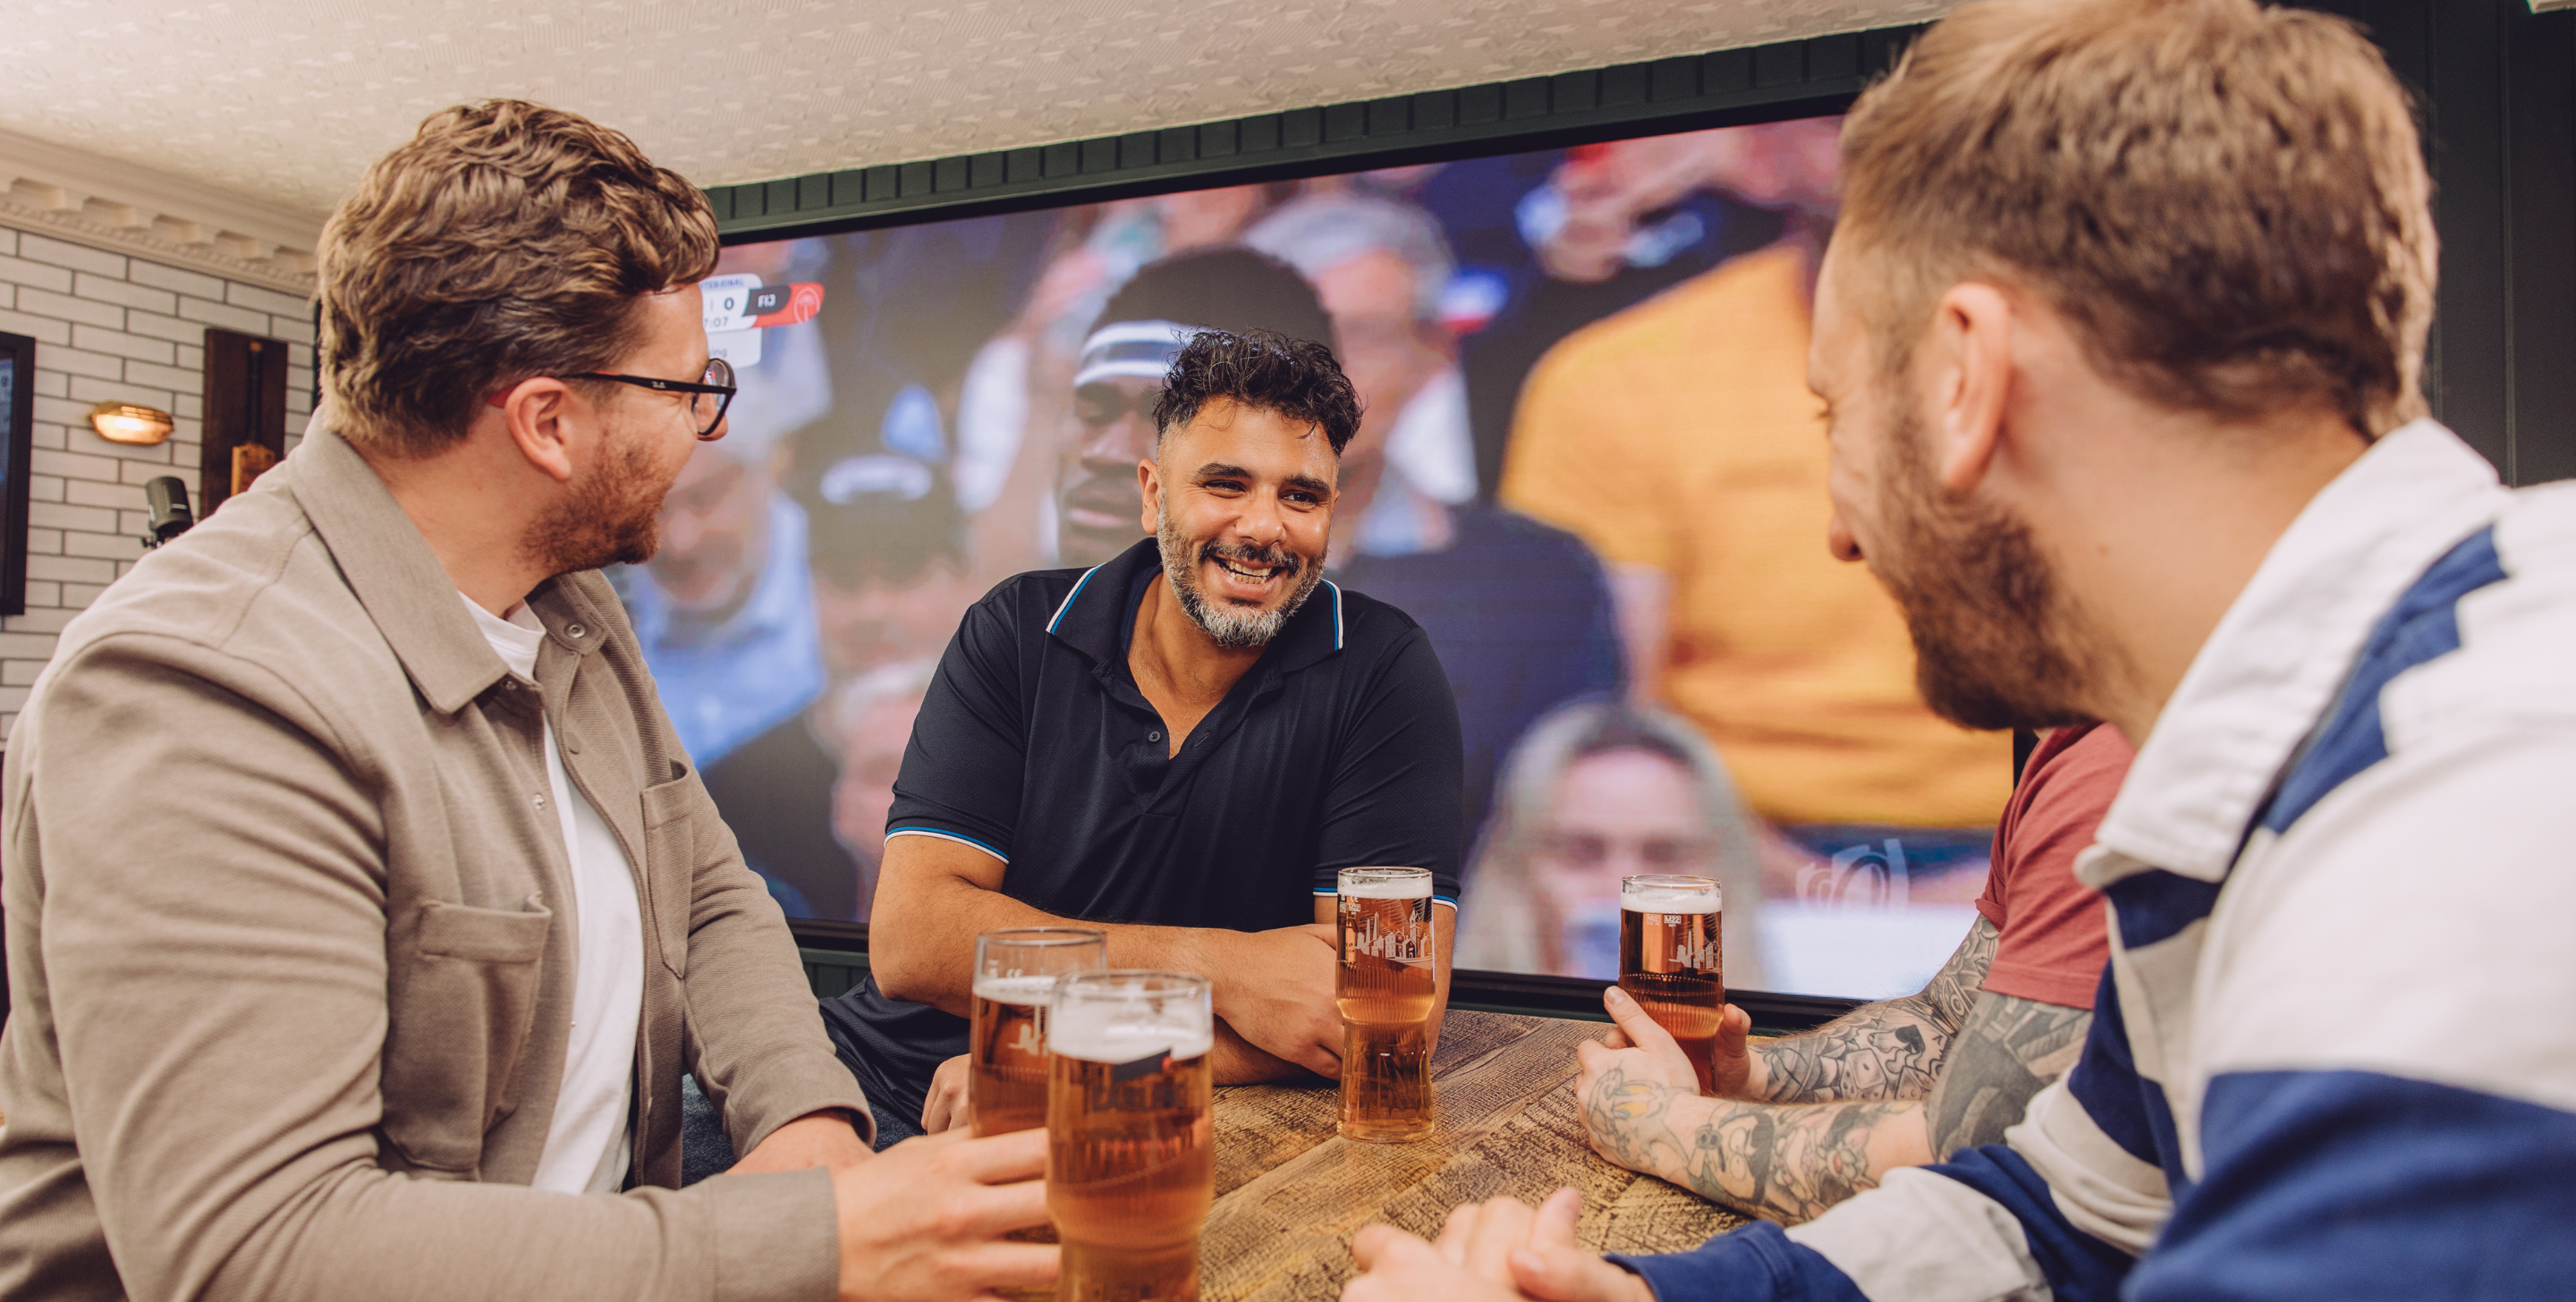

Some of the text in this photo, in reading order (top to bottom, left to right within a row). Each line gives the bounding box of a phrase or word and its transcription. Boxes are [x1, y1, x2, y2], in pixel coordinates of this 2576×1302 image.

[724, 297, 733, 310] 0
[758, 293, 776, 309] FIJ
[1664, 915, 1681, 924] M22
